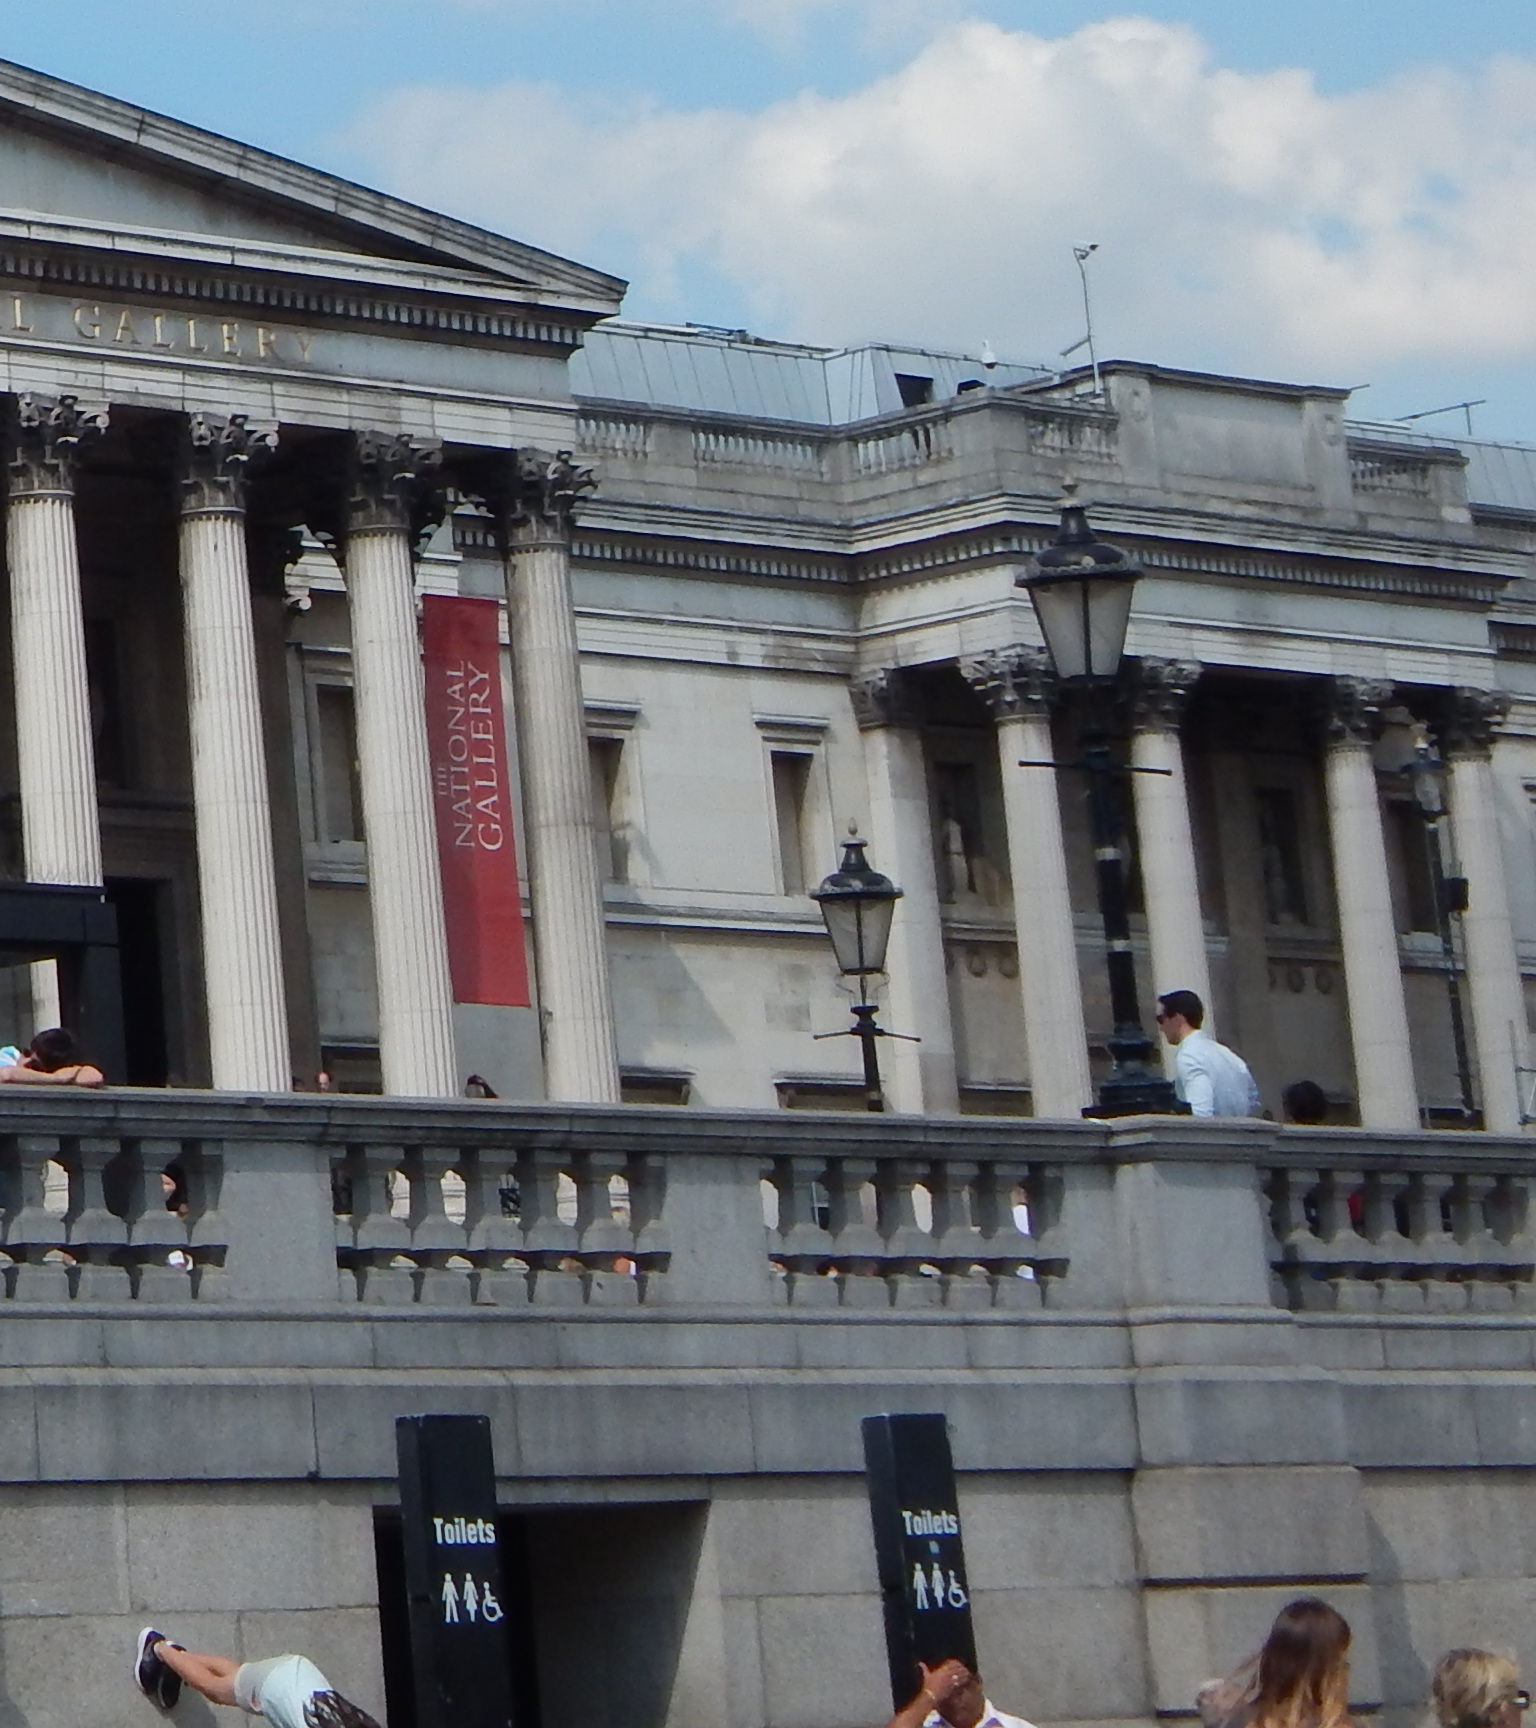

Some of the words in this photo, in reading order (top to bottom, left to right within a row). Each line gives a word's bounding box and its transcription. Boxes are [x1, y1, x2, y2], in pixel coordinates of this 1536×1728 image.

[73, 304, 318, 365] GALLERY
[446, 660, 475, 848] NATIONAL
[467, 661, 504, 851] GALLERY
[433, 1517, 496, 1545] Toilets
[902, 1510, 958, 1536] Toilets
